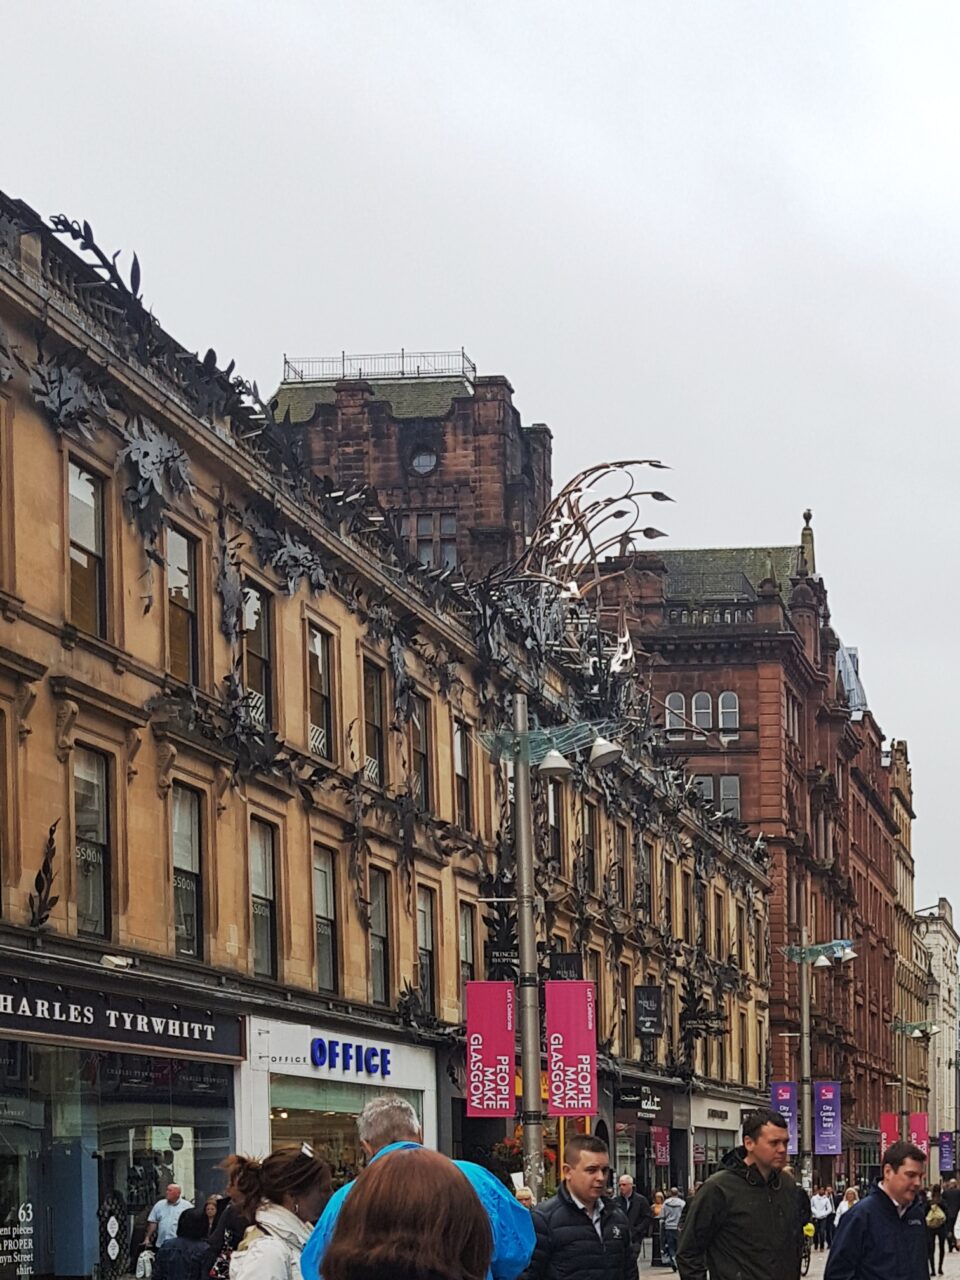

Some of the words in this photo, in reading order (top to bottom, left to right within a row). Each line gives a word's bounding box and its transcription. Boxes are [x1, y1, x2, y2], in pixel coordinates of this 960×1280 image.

[0, 994, 94, 1024] HARLES
[106, 1010, 216, 1041] TYRWHITT
[271, 1056, 308, 1064] OFFICE
[310, 1037, 391, 1077] OFFICE
[470, 1033, 483, 1109] GLASGOW
[550, 1033, 564, 1109] GLASGOW
[483, 1067, 496, 1109] MAKE
[496, 1055, 509, 1109] PEOPLE
[565, 1066, 578, 1109] MAKE
[577, 1055, 591, 1109] PEOPLE
[12, 1224, 34, 1238] pieces
[18, 1203, 33, 1222] 63
[3, 1238, 34, 1251] PROPER
[13, 1251, 34, 1263] Street
[16, 1264, 34, 1275] shirt.
